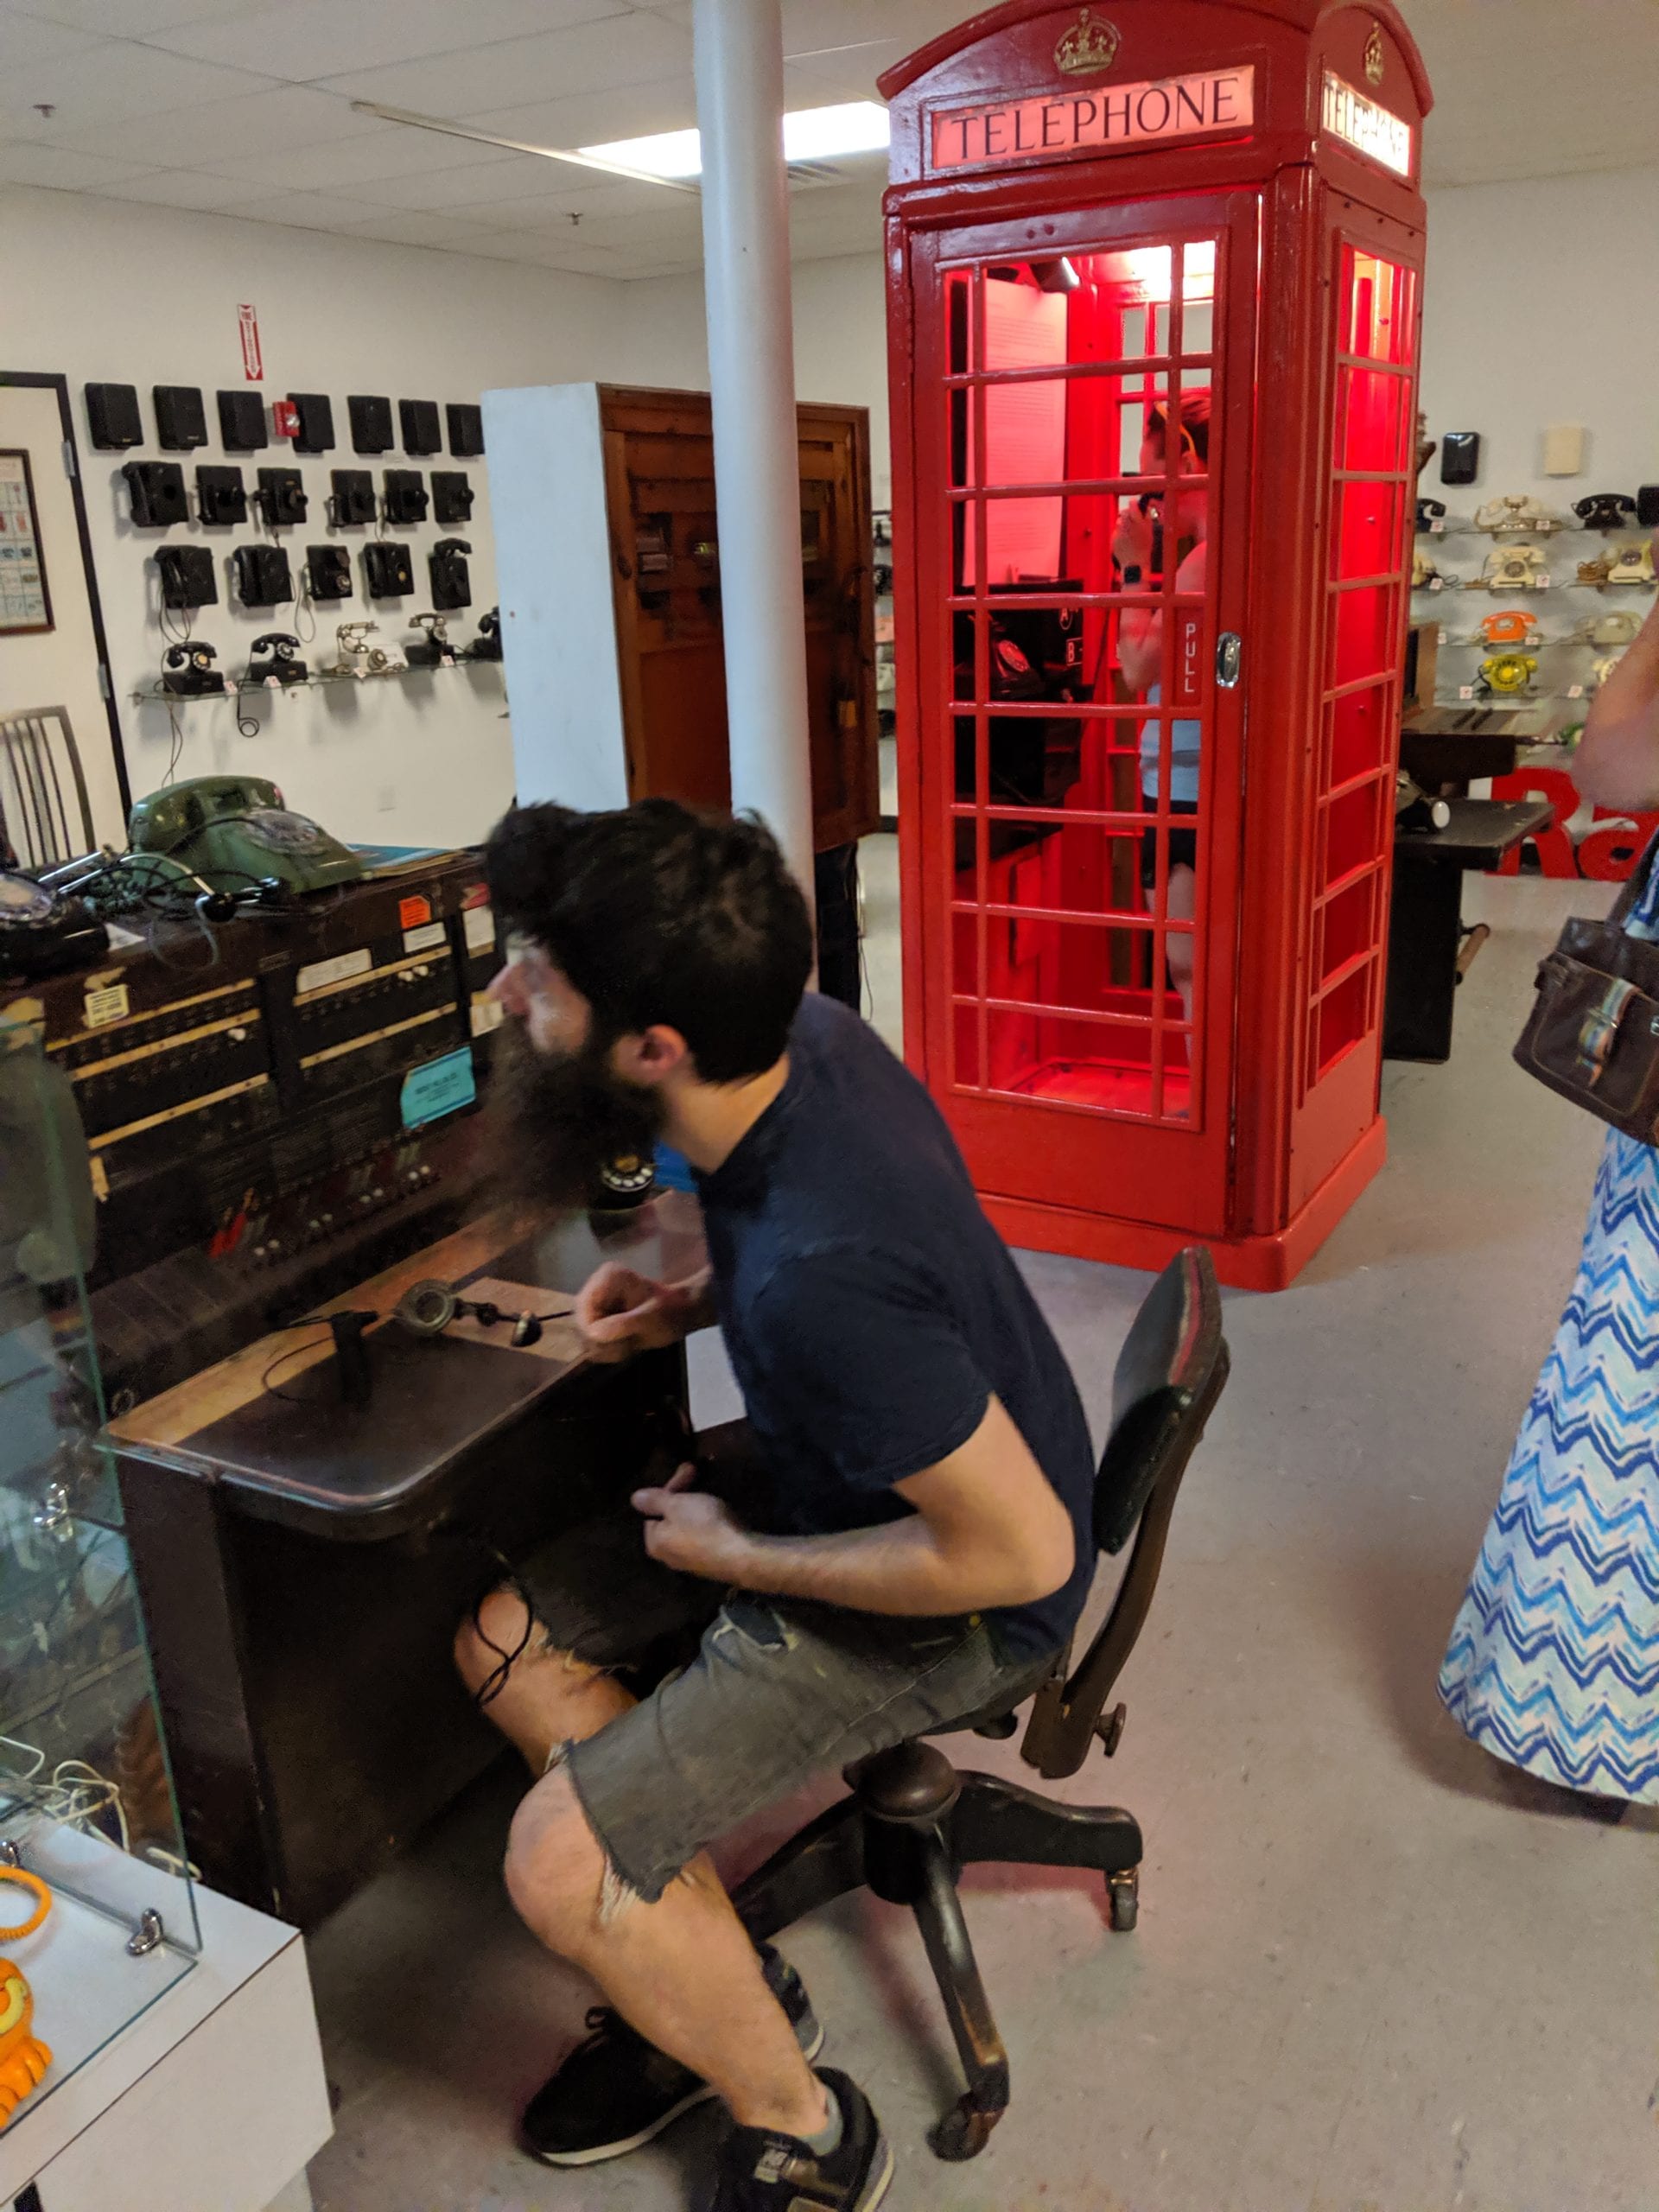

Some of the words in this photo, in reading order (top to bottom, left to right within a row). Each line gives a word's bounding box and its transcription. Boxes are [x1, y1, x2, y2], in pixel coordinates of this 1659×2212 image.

[951, 77, 1239, 161] TELEPHONE
[1322, 81, 1405, 170] TELEPHN
[1067, 642, 1075, 663] B
[1184, 622, 1197, 694] PULL
